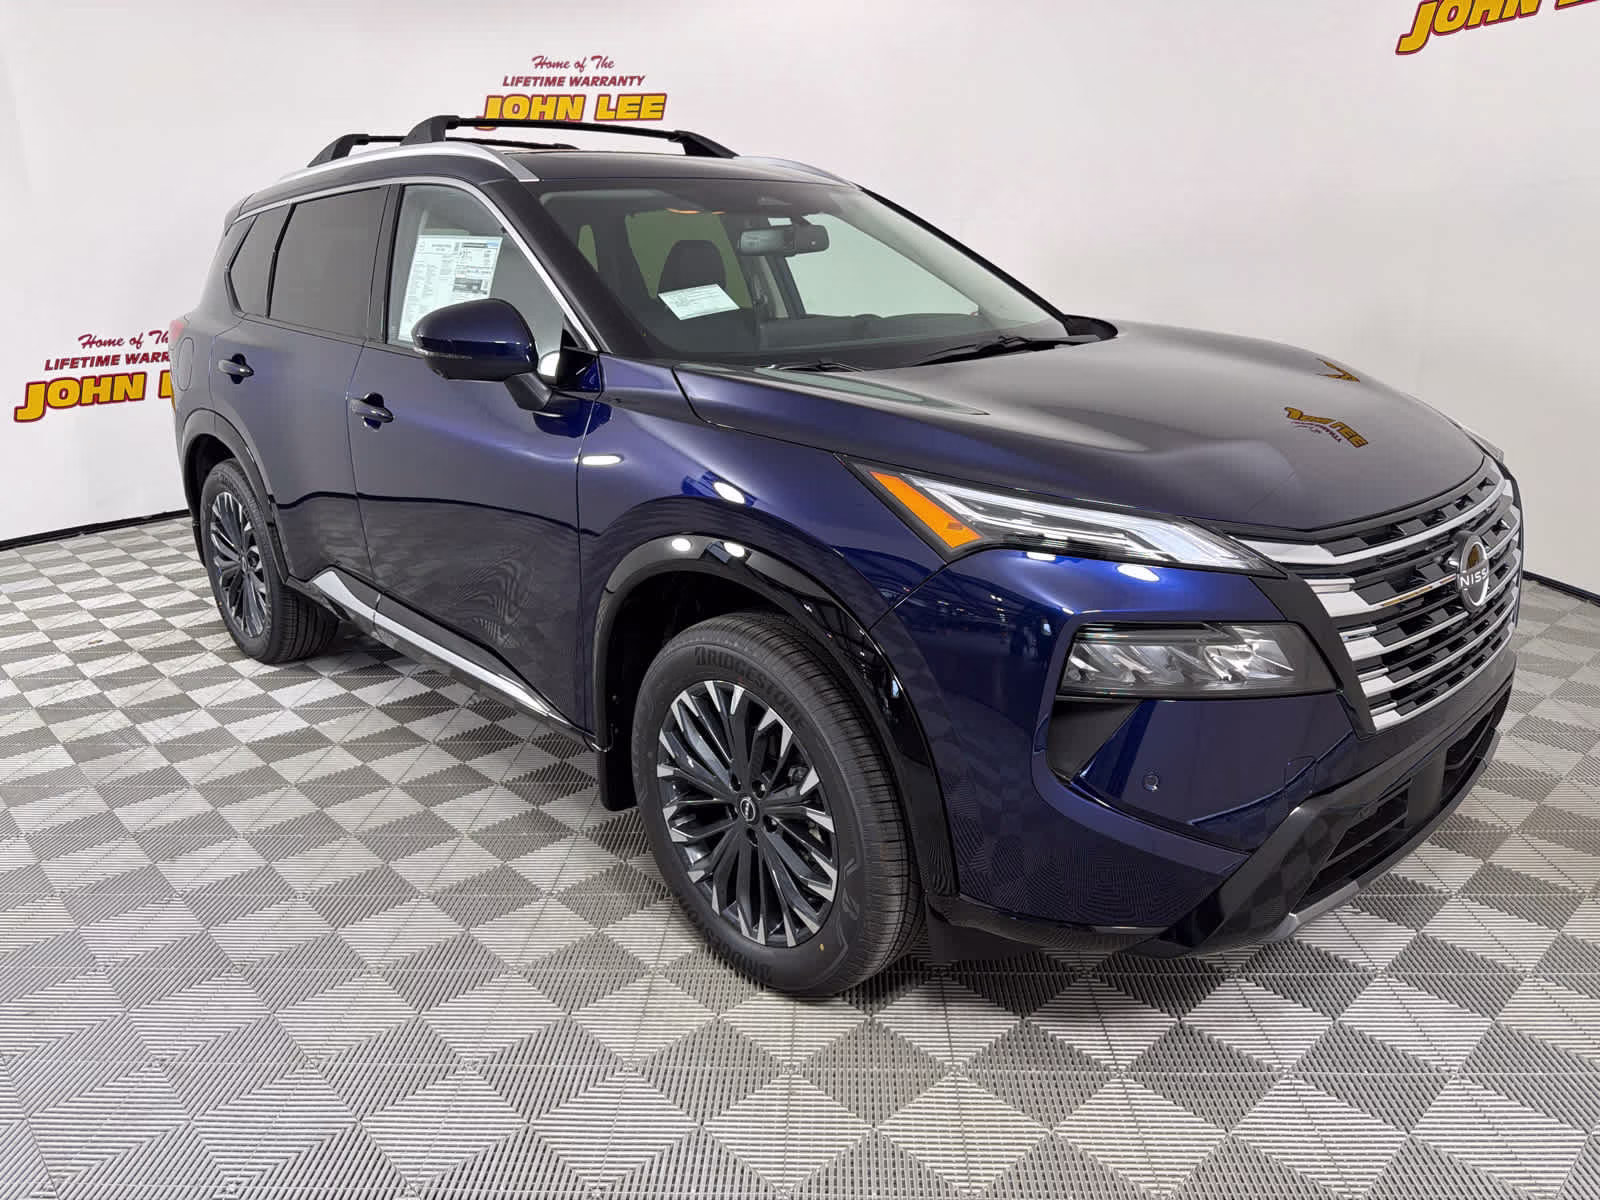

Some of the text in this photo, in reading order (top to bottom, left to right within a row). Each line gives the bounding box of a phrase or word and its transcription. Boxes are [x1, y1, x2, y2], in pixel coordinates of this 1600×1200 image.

[532, 55, 615, 72] Home of The
[502, 75, 646, 87] LIFETIME WARRANTY
[475, 93, 667, 131] JOHN LEE
[78, 330, 169, 349] Home of Th
[44, 354, 121, 371] LIFETIME
[14, 371, 148, 423] JOHN
[1460, 567, 1488, 588] NISS
